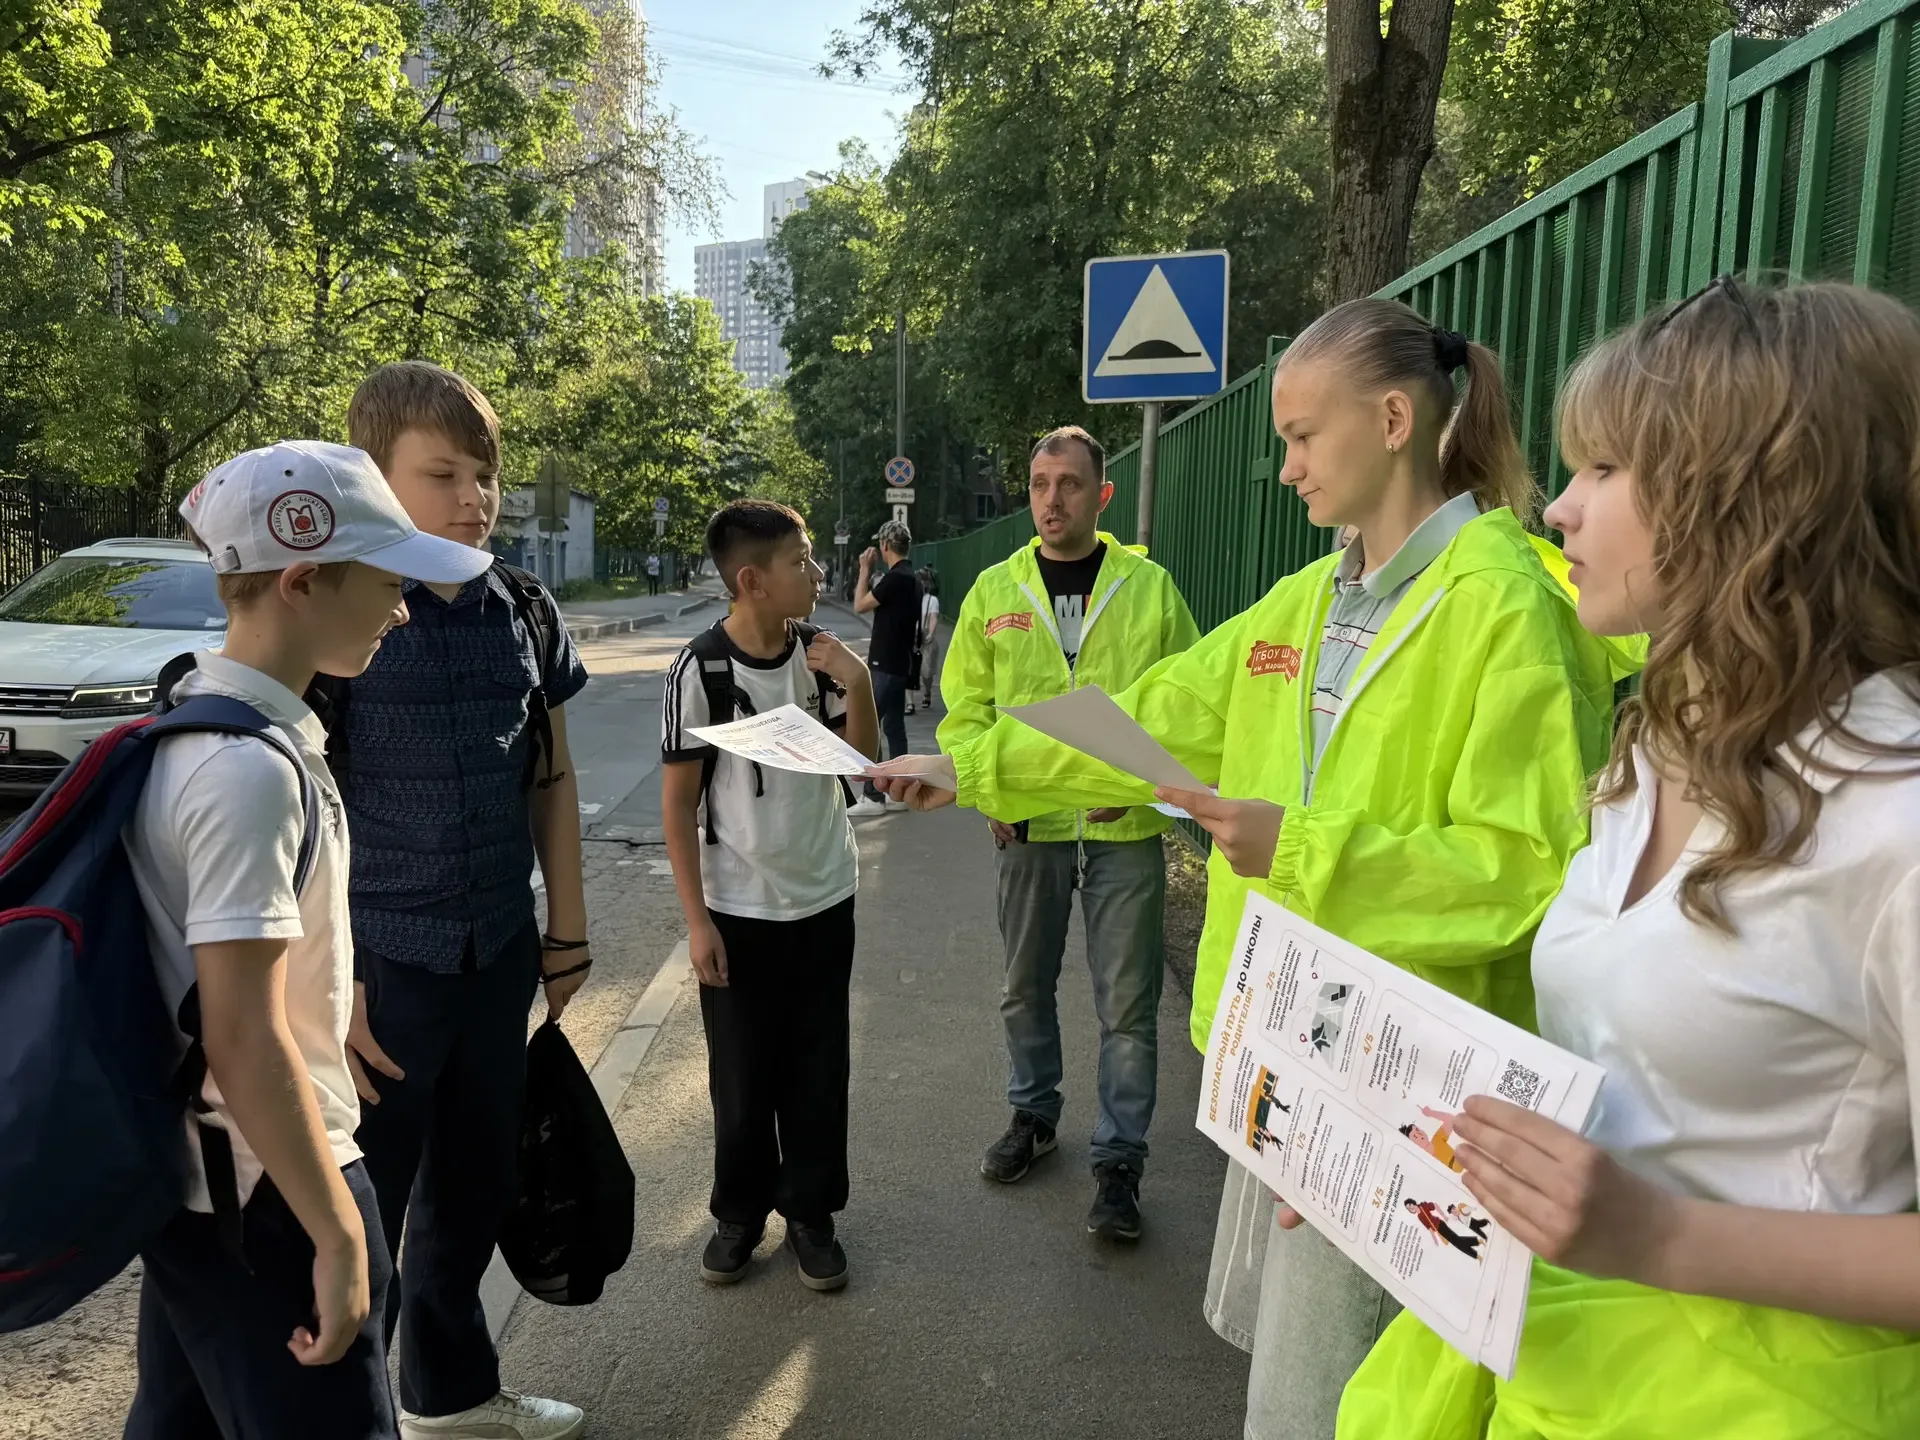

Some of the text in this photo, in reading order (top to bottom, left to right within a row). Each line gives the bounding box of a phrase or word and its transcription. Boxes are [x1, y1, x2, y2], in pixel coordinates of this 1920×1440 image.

[292, 532, 323, 544] МОСКВЫ
[1256, 648, 1280, 661] ГБОУ
[1287, 946, 1297, 971] школы,
[1265, 968, 1276, 991] 2/5
[1265, 989, 1279, 1031] Проговорите
[1283, 939, 1293, 961] местах
[1284, 971, 1290, 981] до
[1274, 1005, 1282, 1021] пути
[1278, 997, 1283, 1005] от
[1209, 913, 1262, 1122] БЕЗОПАСНЫЙ ПУТЬ ДО ШКОЛЫ
[1229, 985, 1254, 1056] РОДИТЕЛЯМ
[1272, 1020, 1277, 1030] по
[1360, 1031, 1375, 1057] 4/5
[1368, 1012, 1391, 1088] Регулярно тренируйте
[1376, 1022, 1395, 1085] внимание ребёнка
[1381, 1024, 1401, 1091] во время движения
[1392, 1047, 1403, 1077] на улице
[1300, 1101, 1324, 1189] Маршрут от дома до школы
[1370, 1184, 1385, 1210] 3/5
[1372, 1162, 1400, 1245] Повторно пройдите весь
[1381, 1213, 1393, 1243] маршрут
[1391, 1173, 1404, 1208] ребёнком
